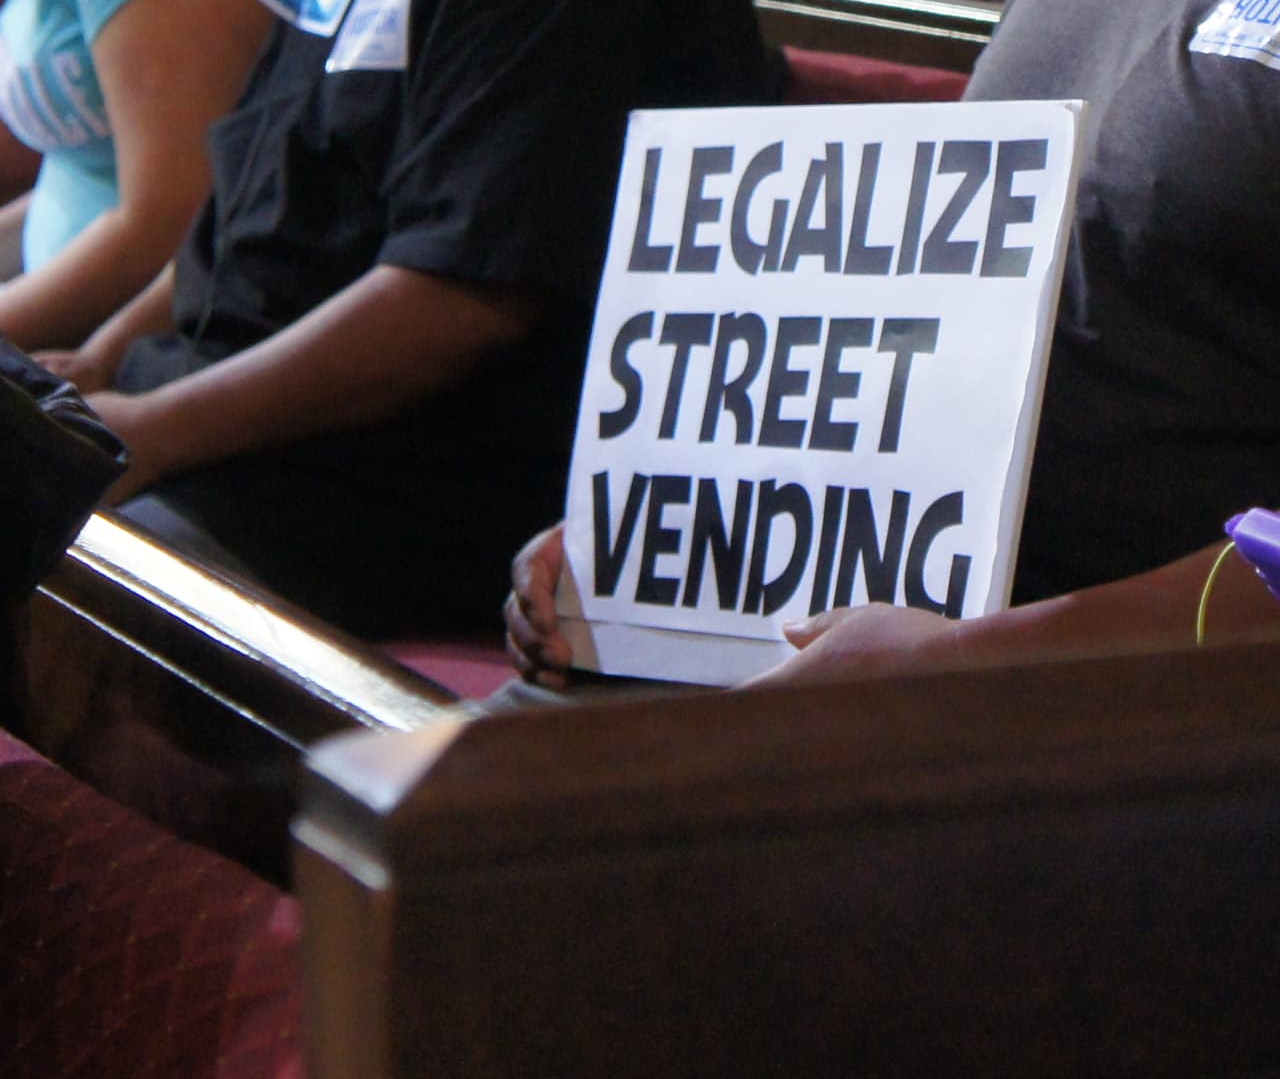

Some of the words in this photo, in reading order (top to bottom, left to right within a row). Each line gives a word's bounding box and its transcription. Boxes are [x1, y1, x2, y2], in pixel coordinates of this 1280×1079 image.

[627, 138, 1049, 277] LEGALIZE
[598, 311, 941, 453] STREET
[592, 470, 972, 620] VENDING
